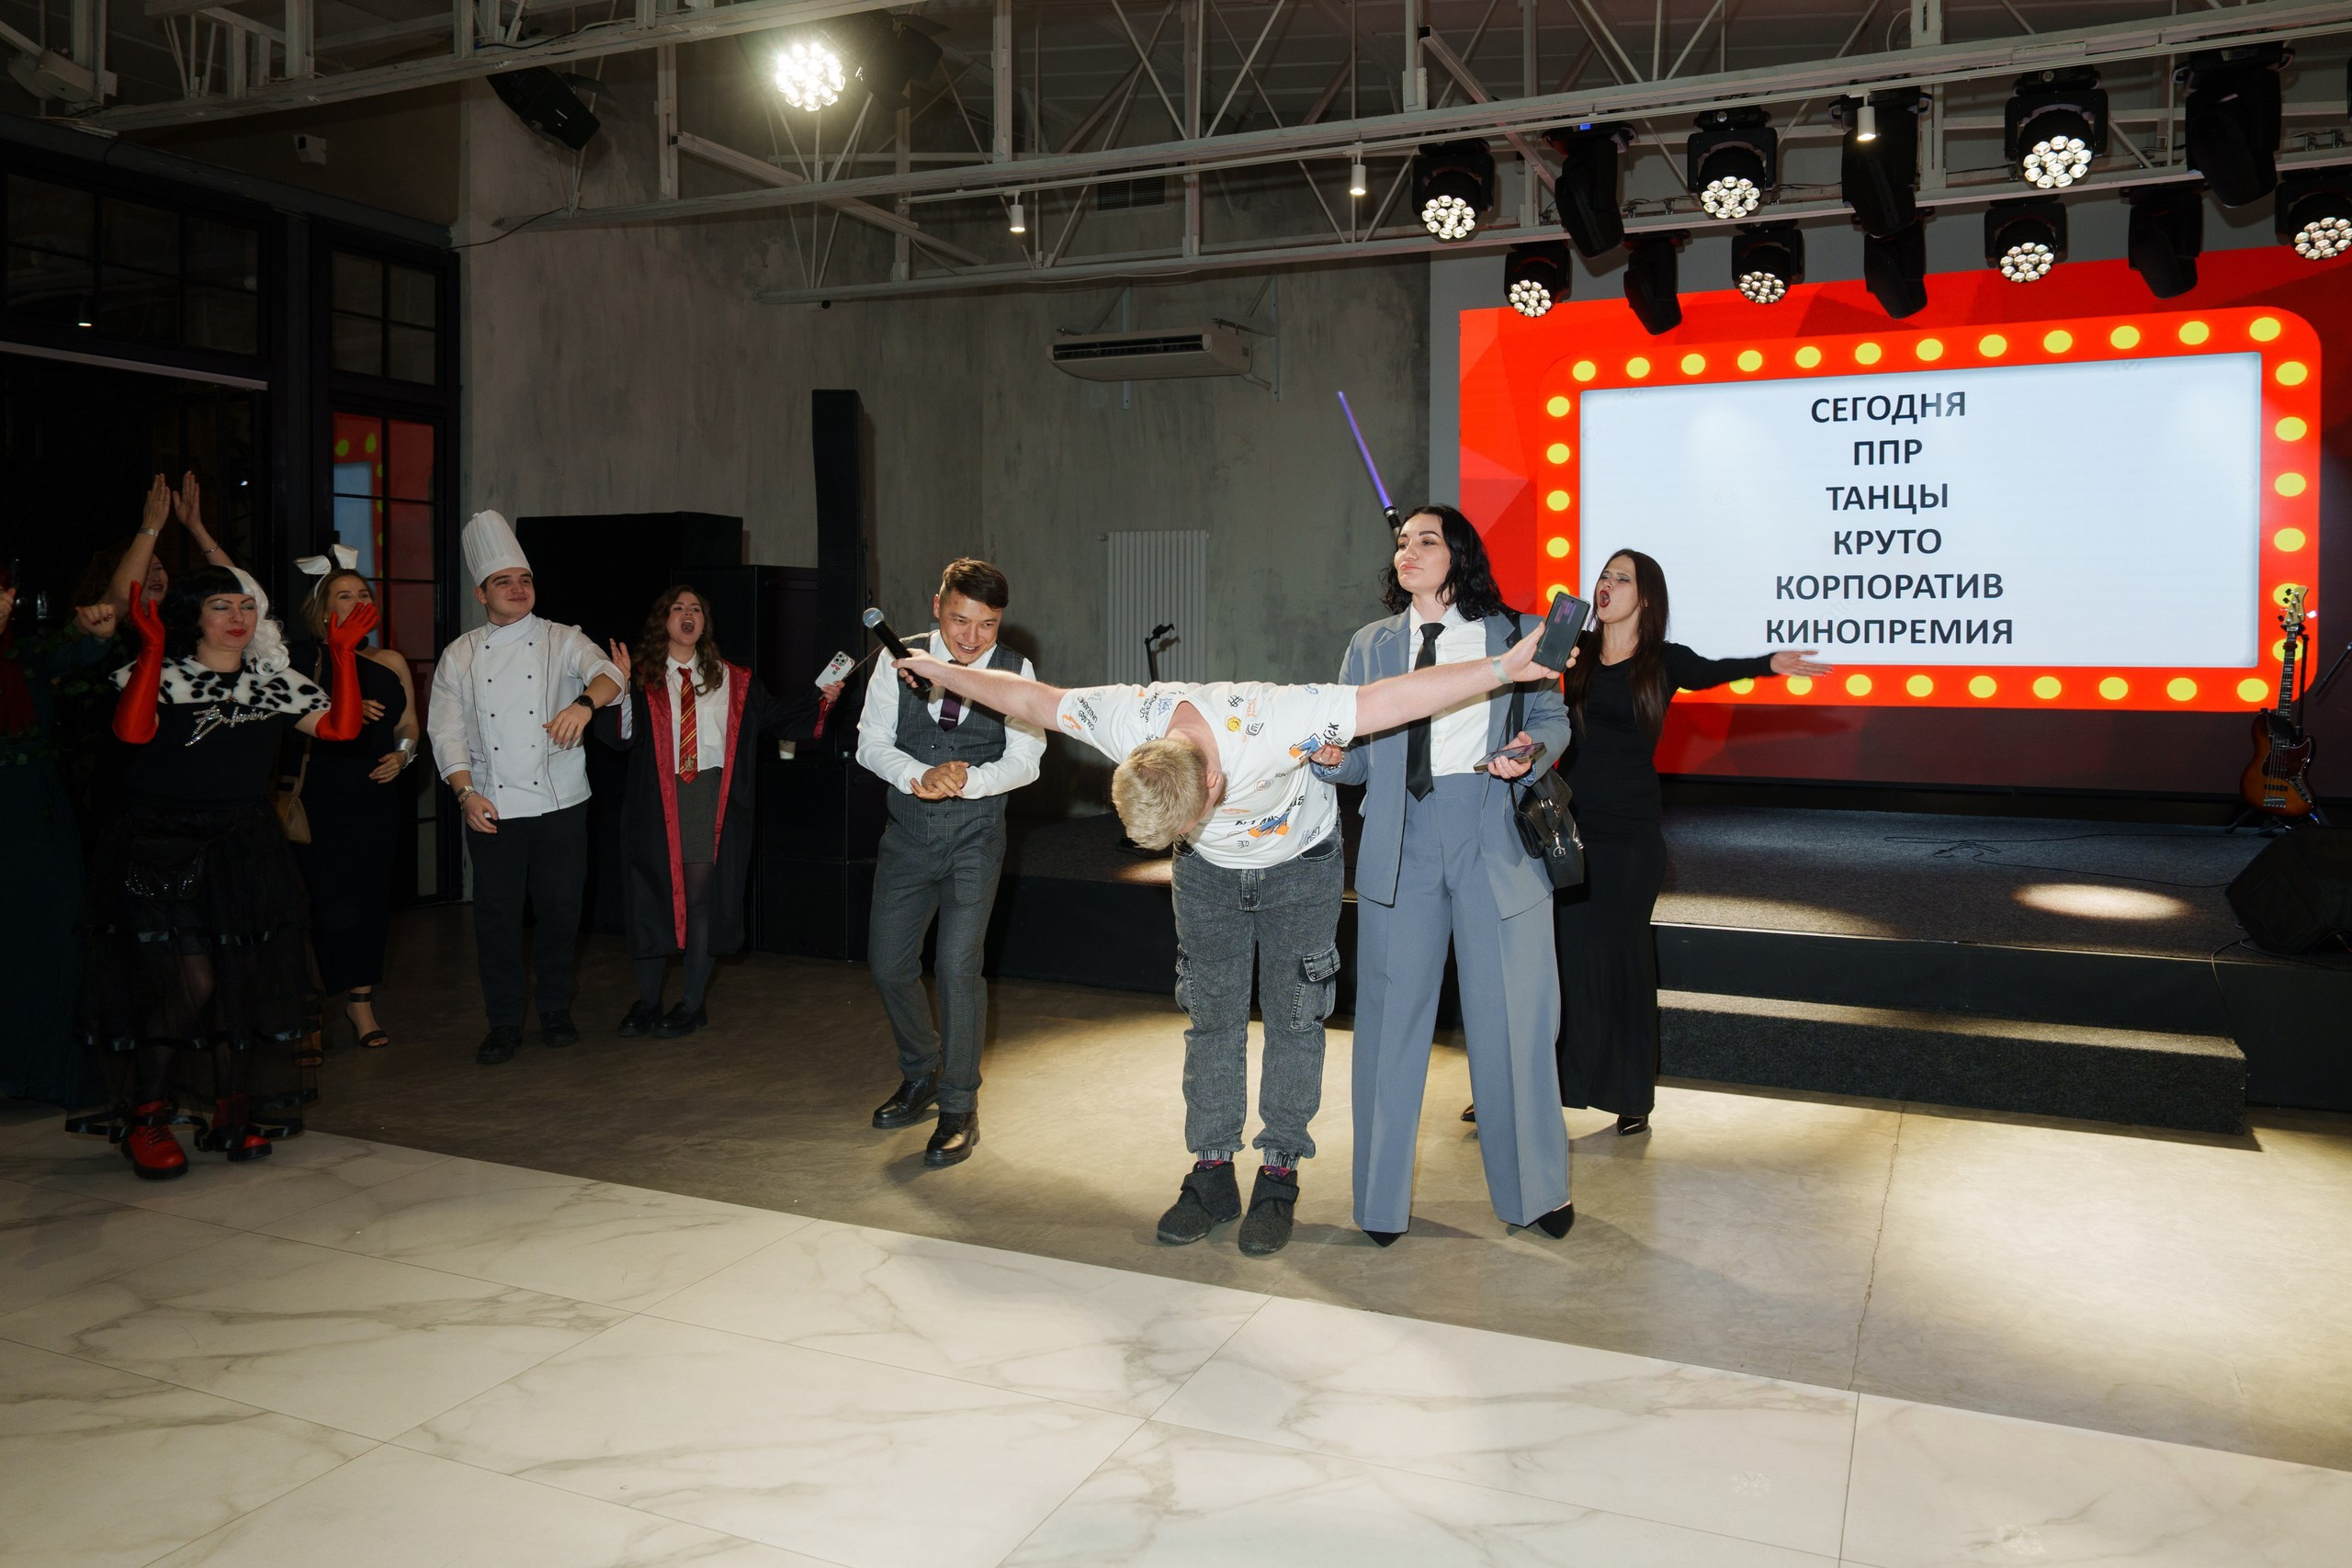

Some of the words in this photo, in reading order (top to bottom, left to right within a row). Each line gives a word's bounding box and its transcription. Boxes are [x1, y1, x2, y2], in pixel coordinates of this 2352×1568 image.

[1811, 390, 1966, 425] СЕГОДНЯ
[1853, 438, 1923, 466] ППР
[1825, 482, 1949, 515] ТАНЦЫ
[1834, 528, 1942, 556] КРУТО
[1776, 573, 2004, 600] КОРПОРАТИВ
[1766, 618, 2013, 645] КИНОПРЕМИЯ
